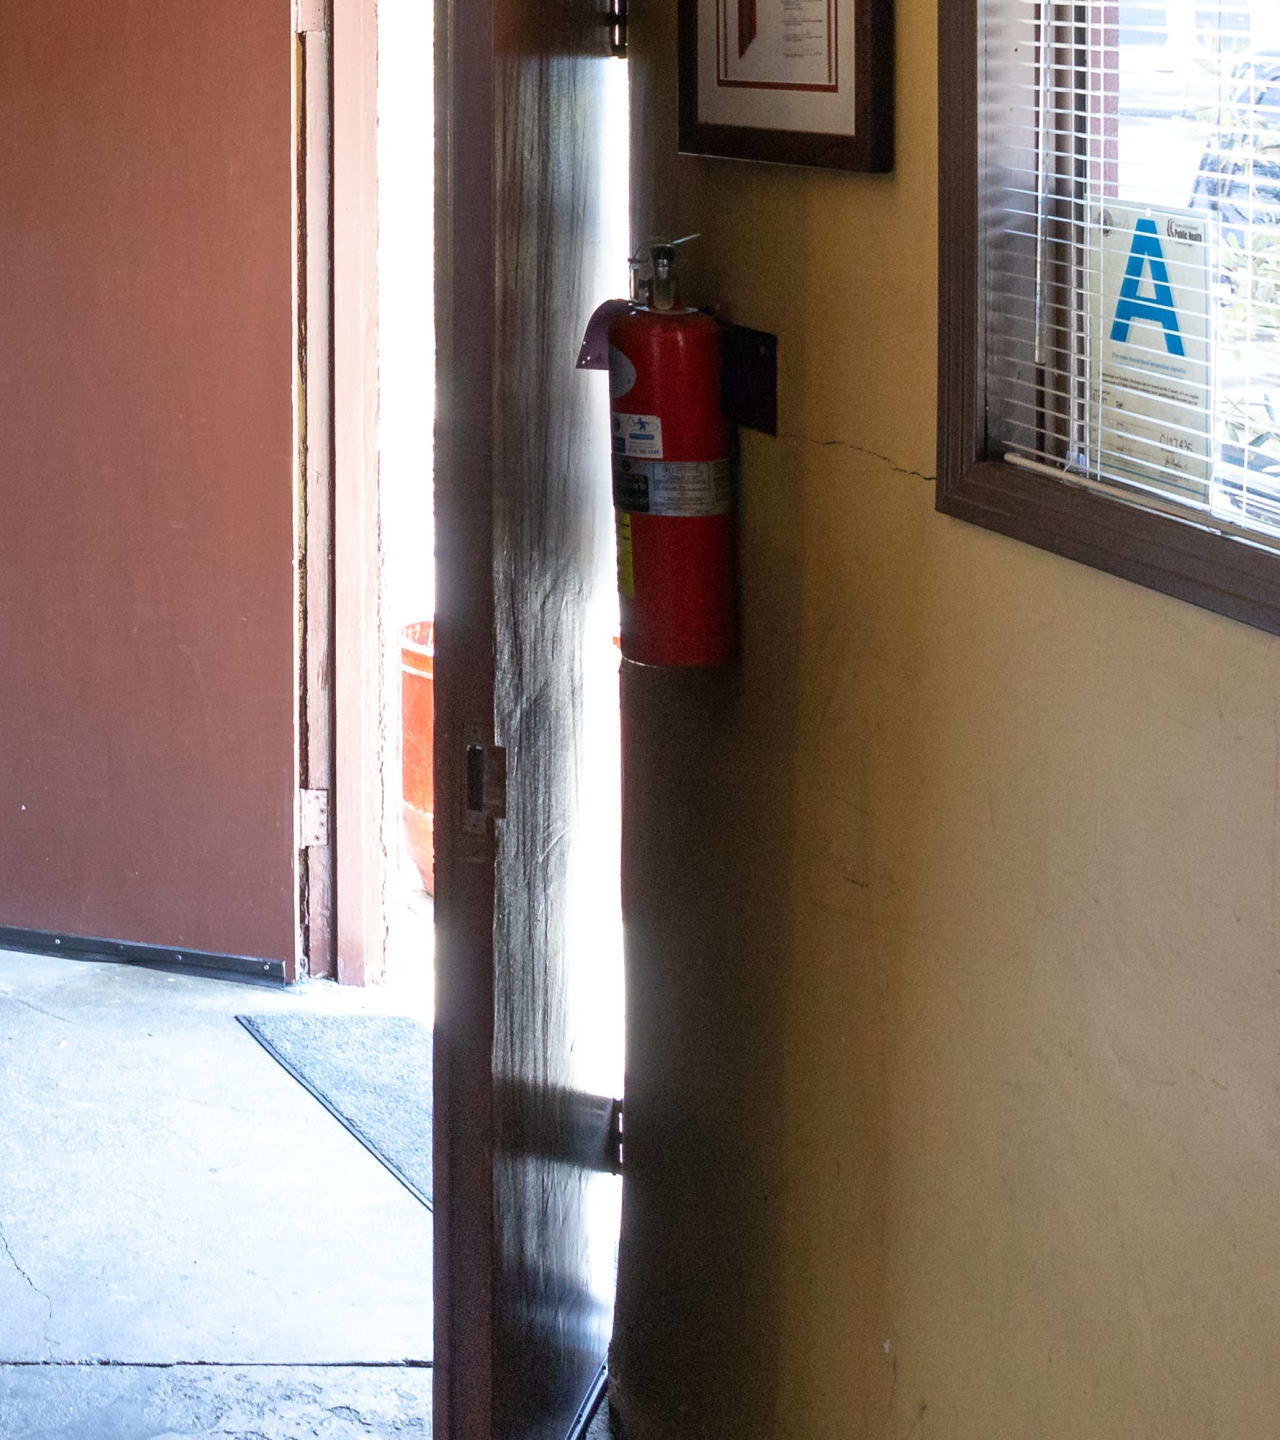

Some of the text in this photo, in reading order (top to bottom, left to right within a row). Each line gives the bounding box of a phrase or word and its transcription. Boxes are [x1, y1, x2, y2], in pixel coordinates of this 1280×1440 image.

[1174, 227, 1202, 243] Public Health
[1109, 218, 1185, 357] A
